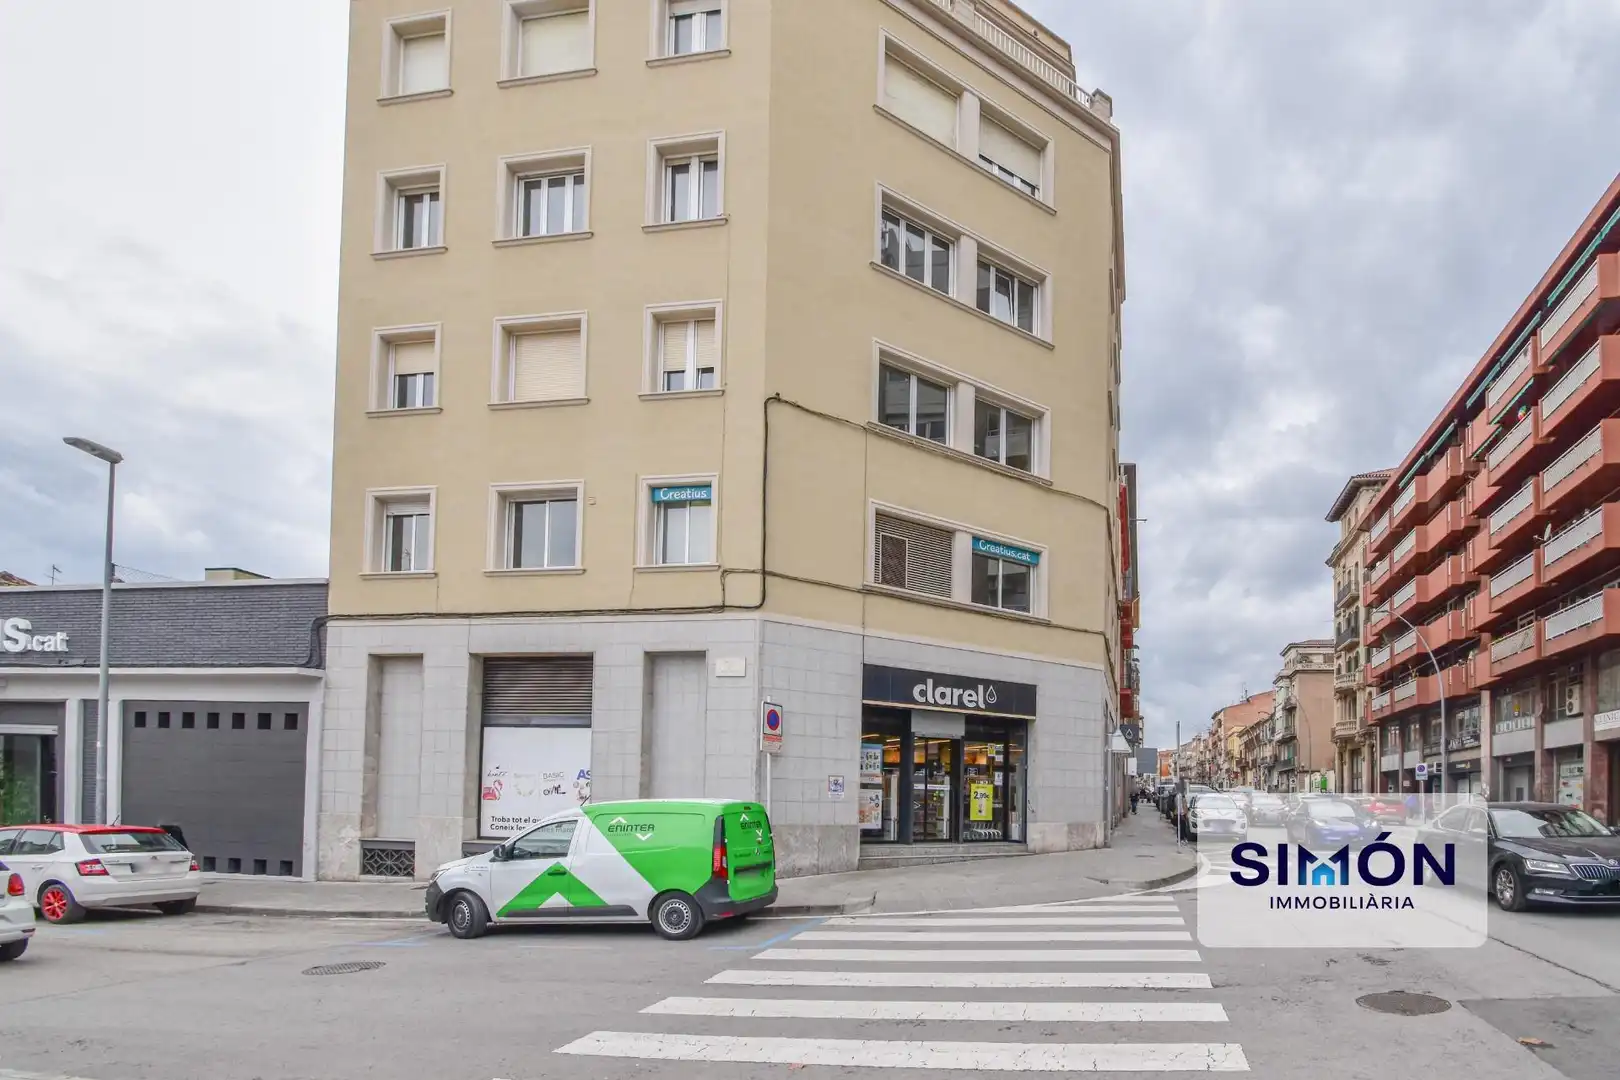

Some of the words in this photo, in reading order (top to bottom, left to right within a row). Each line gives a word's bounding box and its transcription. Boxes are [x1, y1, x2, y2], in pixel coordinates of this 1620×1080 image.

[660, 488, 707, 500] Creatius
[979, 539, 1031, 562] Creatius.cat
[0, 617, 69, 652] S.cat
[912, 678, 986, 709] clarel
[607, 823, 655, 833] ENINTER
